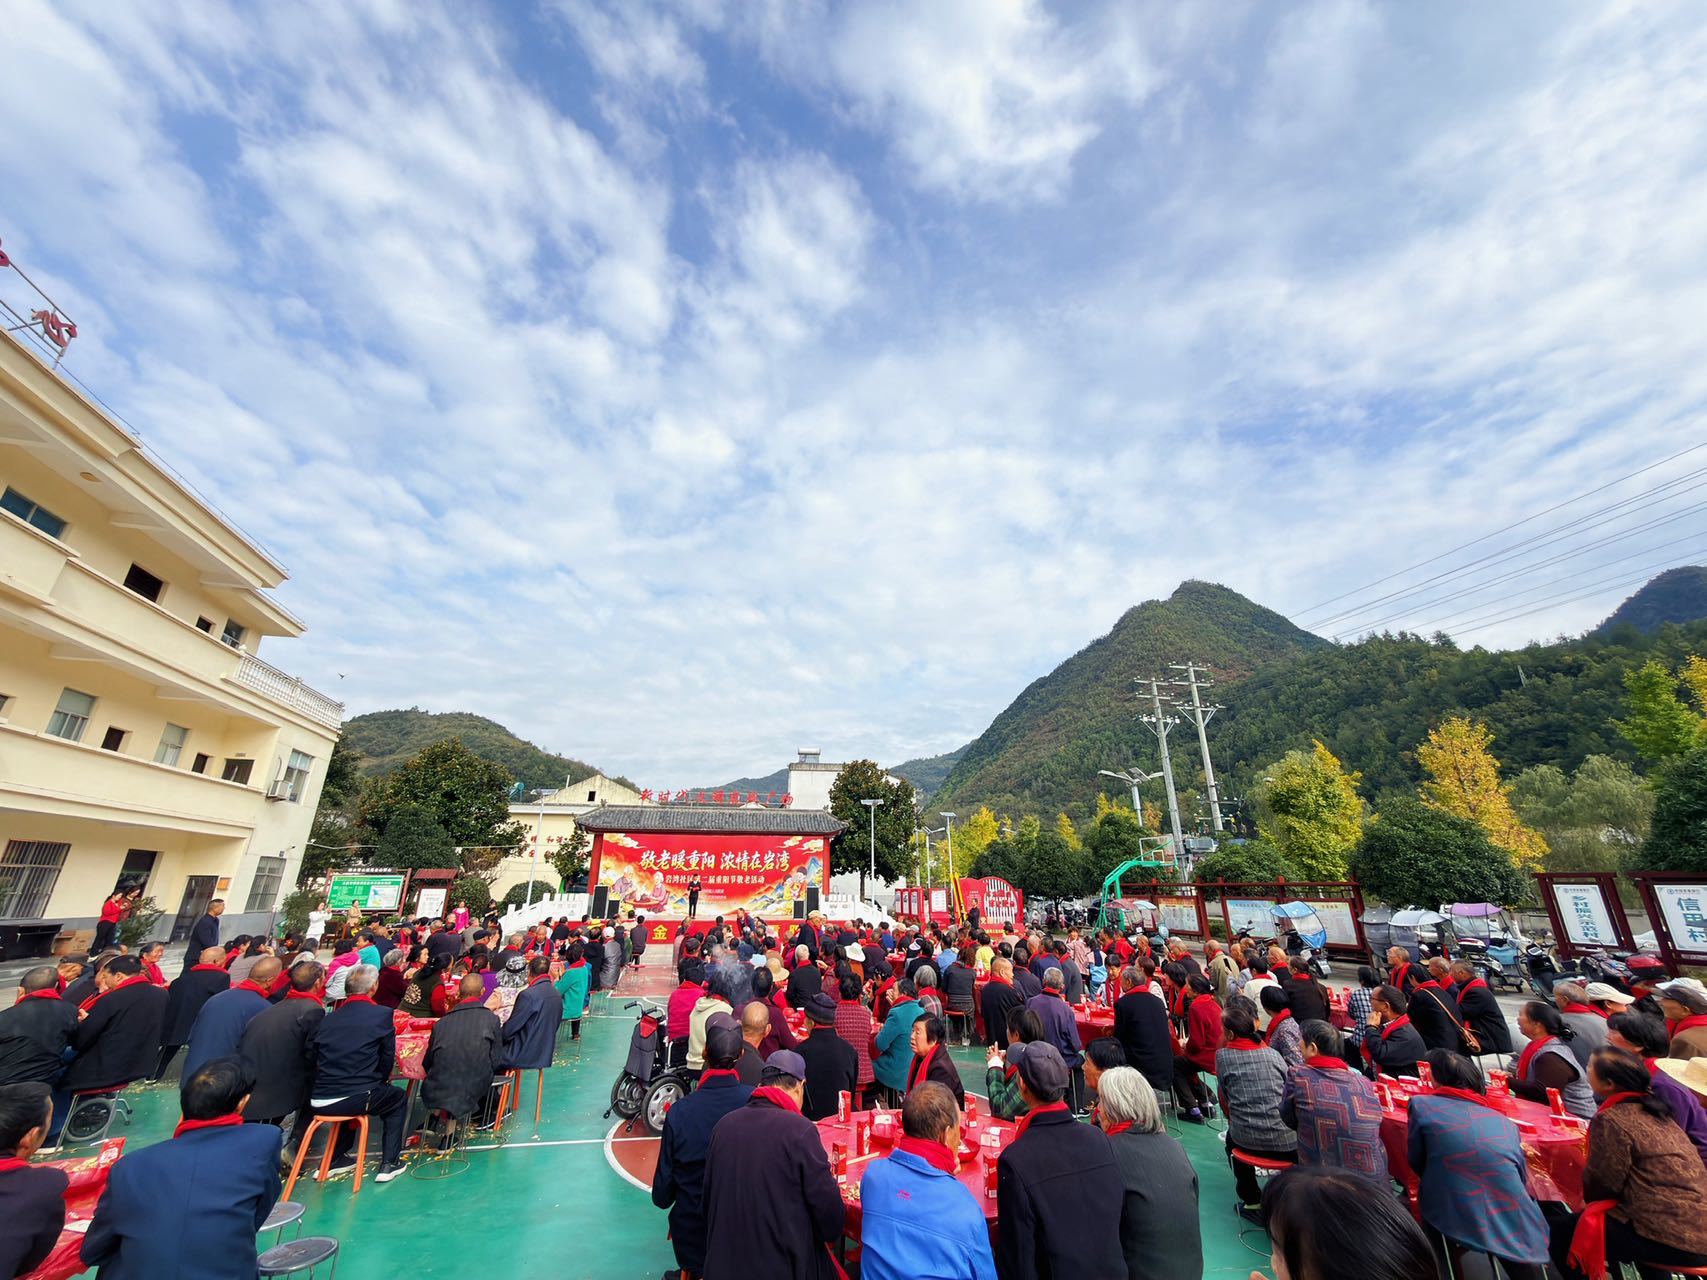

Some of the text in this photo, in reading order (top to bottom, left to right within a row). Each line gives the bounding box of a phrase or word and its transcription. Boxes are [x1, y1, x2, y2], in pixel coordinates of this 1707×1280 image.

[639, 849, 790, 872] 敬老暖重阳 浓情在岩湾
[653, 924, 668, 940] 金
